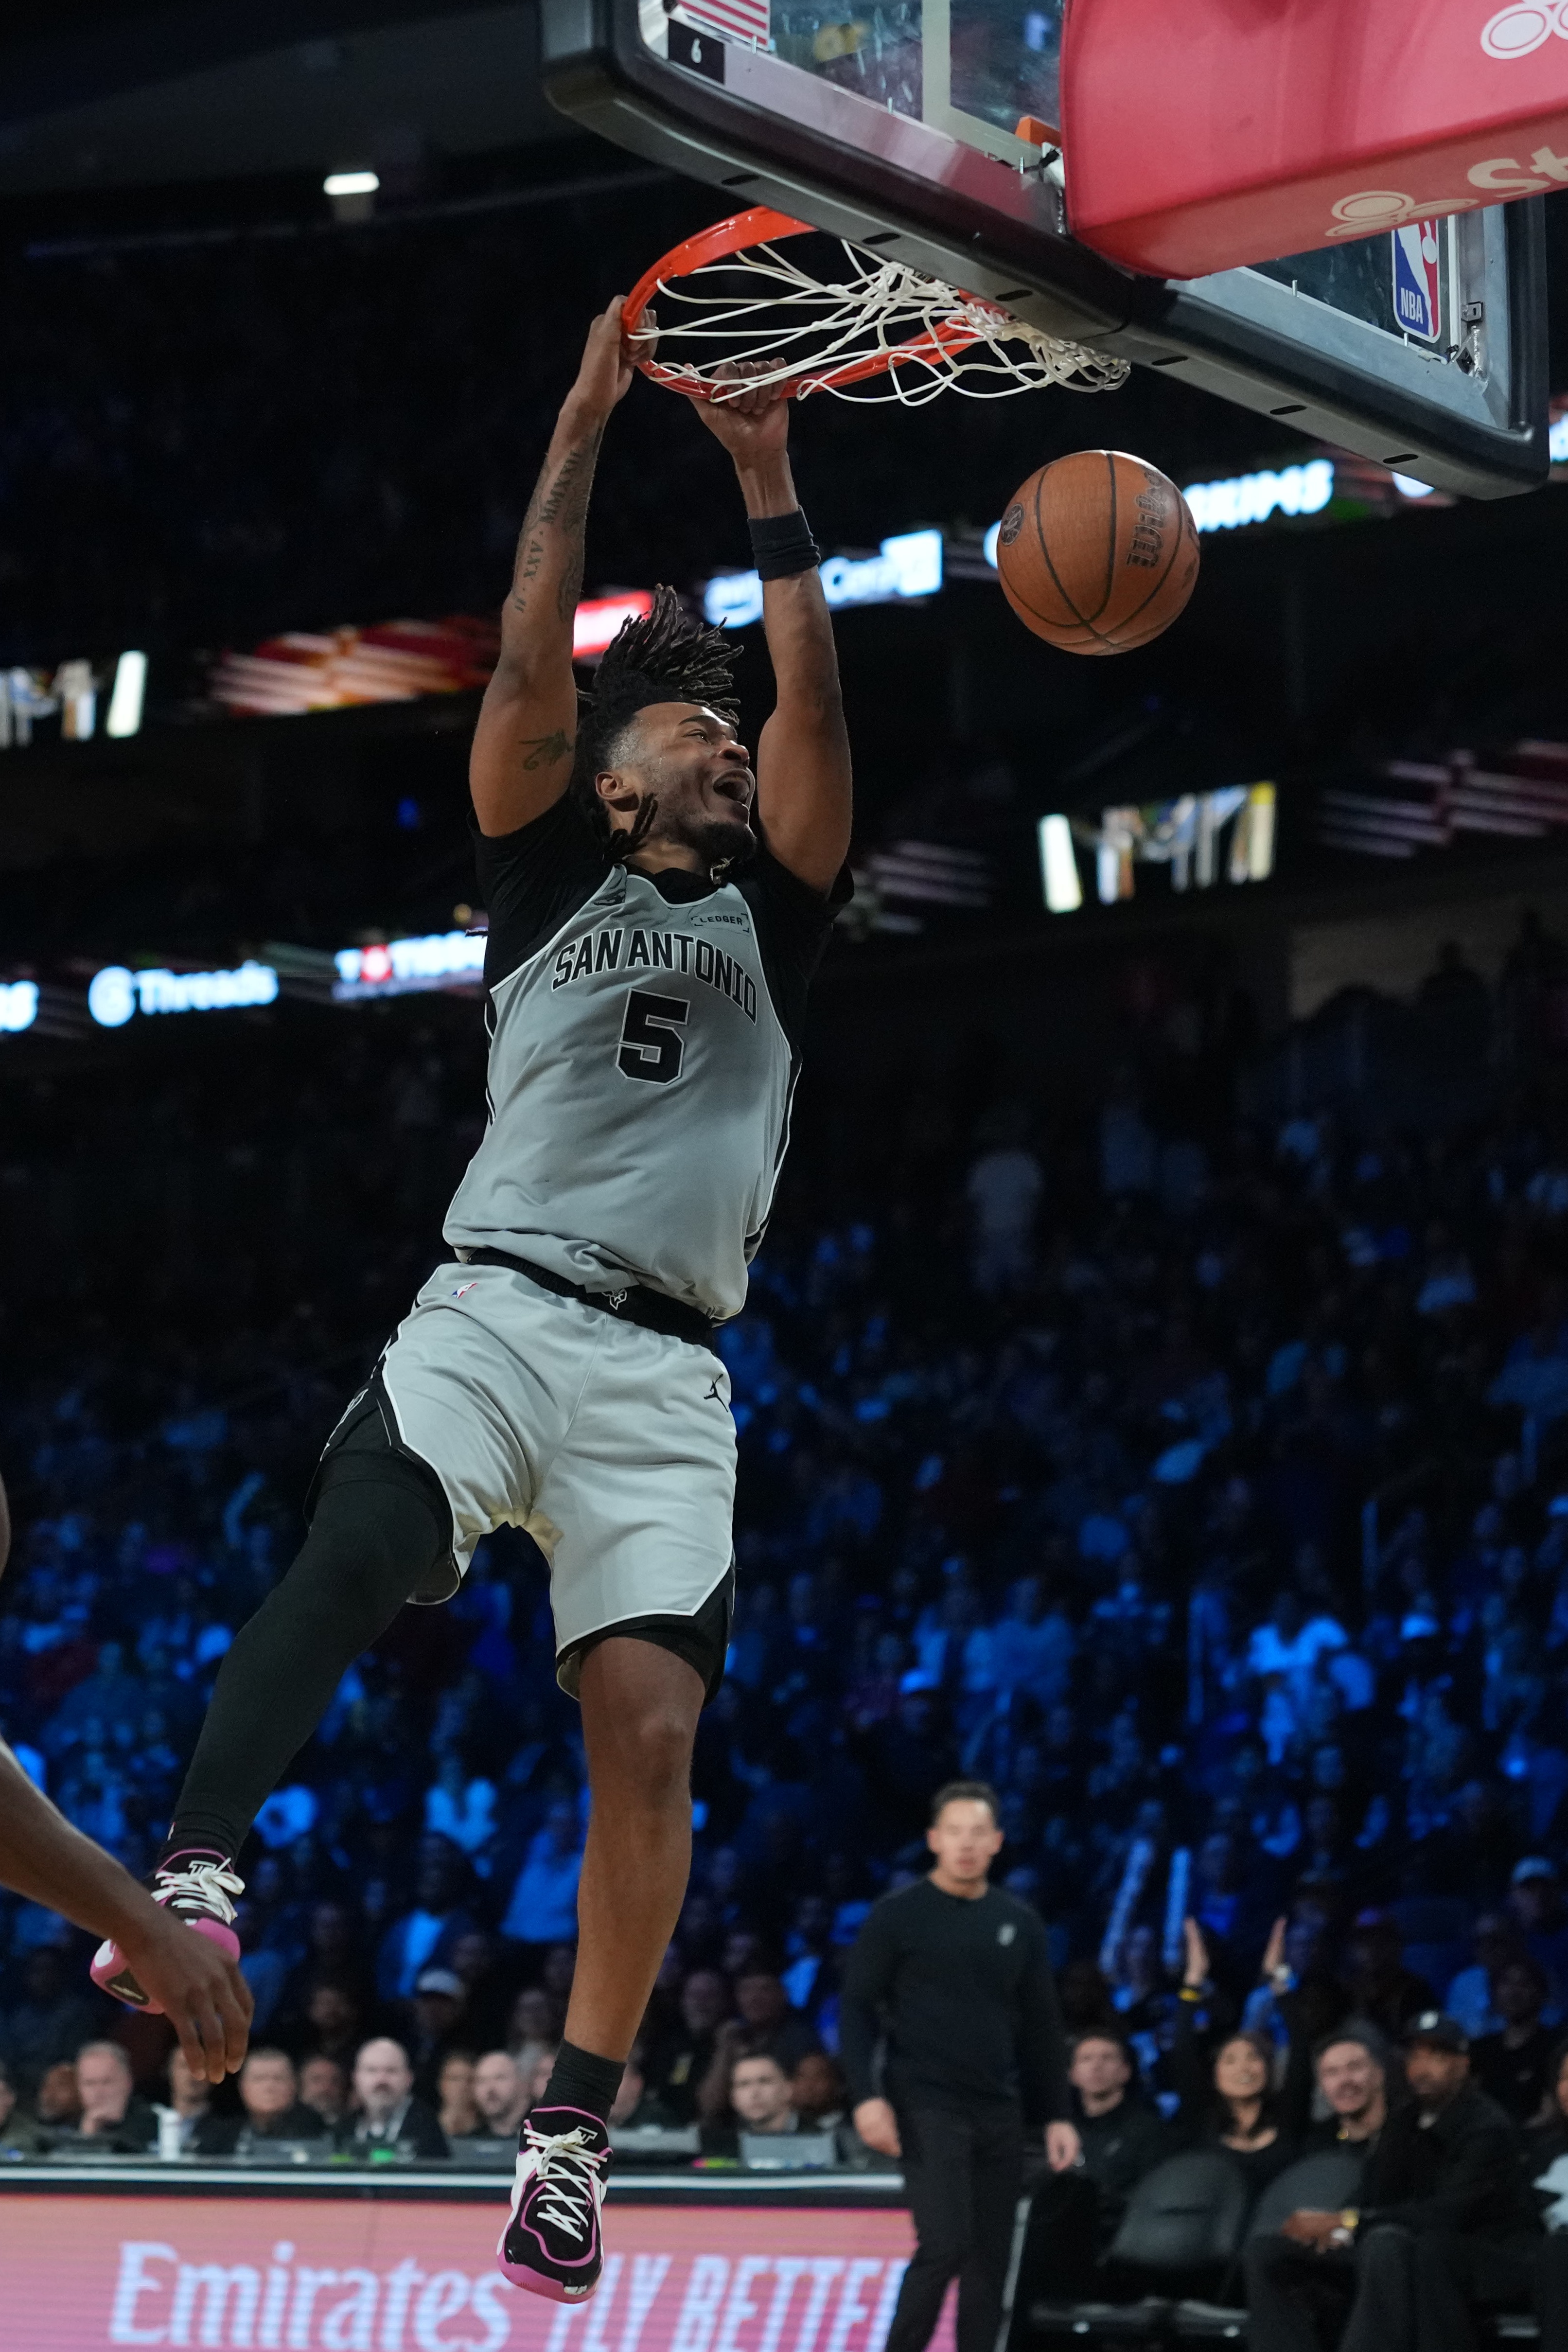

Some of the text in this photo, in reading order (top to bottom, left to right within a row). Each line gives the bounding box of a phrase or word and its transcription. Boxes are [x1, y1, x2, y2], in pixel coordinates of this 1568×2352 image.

[691, 37, 702, 63] 6
[1400, 287, 1423, 325] NBA
[700, 916, 742, 925] LEDGER
[551, 928, 625, 993] SAN
[625, 929, 757, 1026] ANTONIO
[616, 988, 690, 1086] 5
[110, 2241, 512, 2352] Emirates
